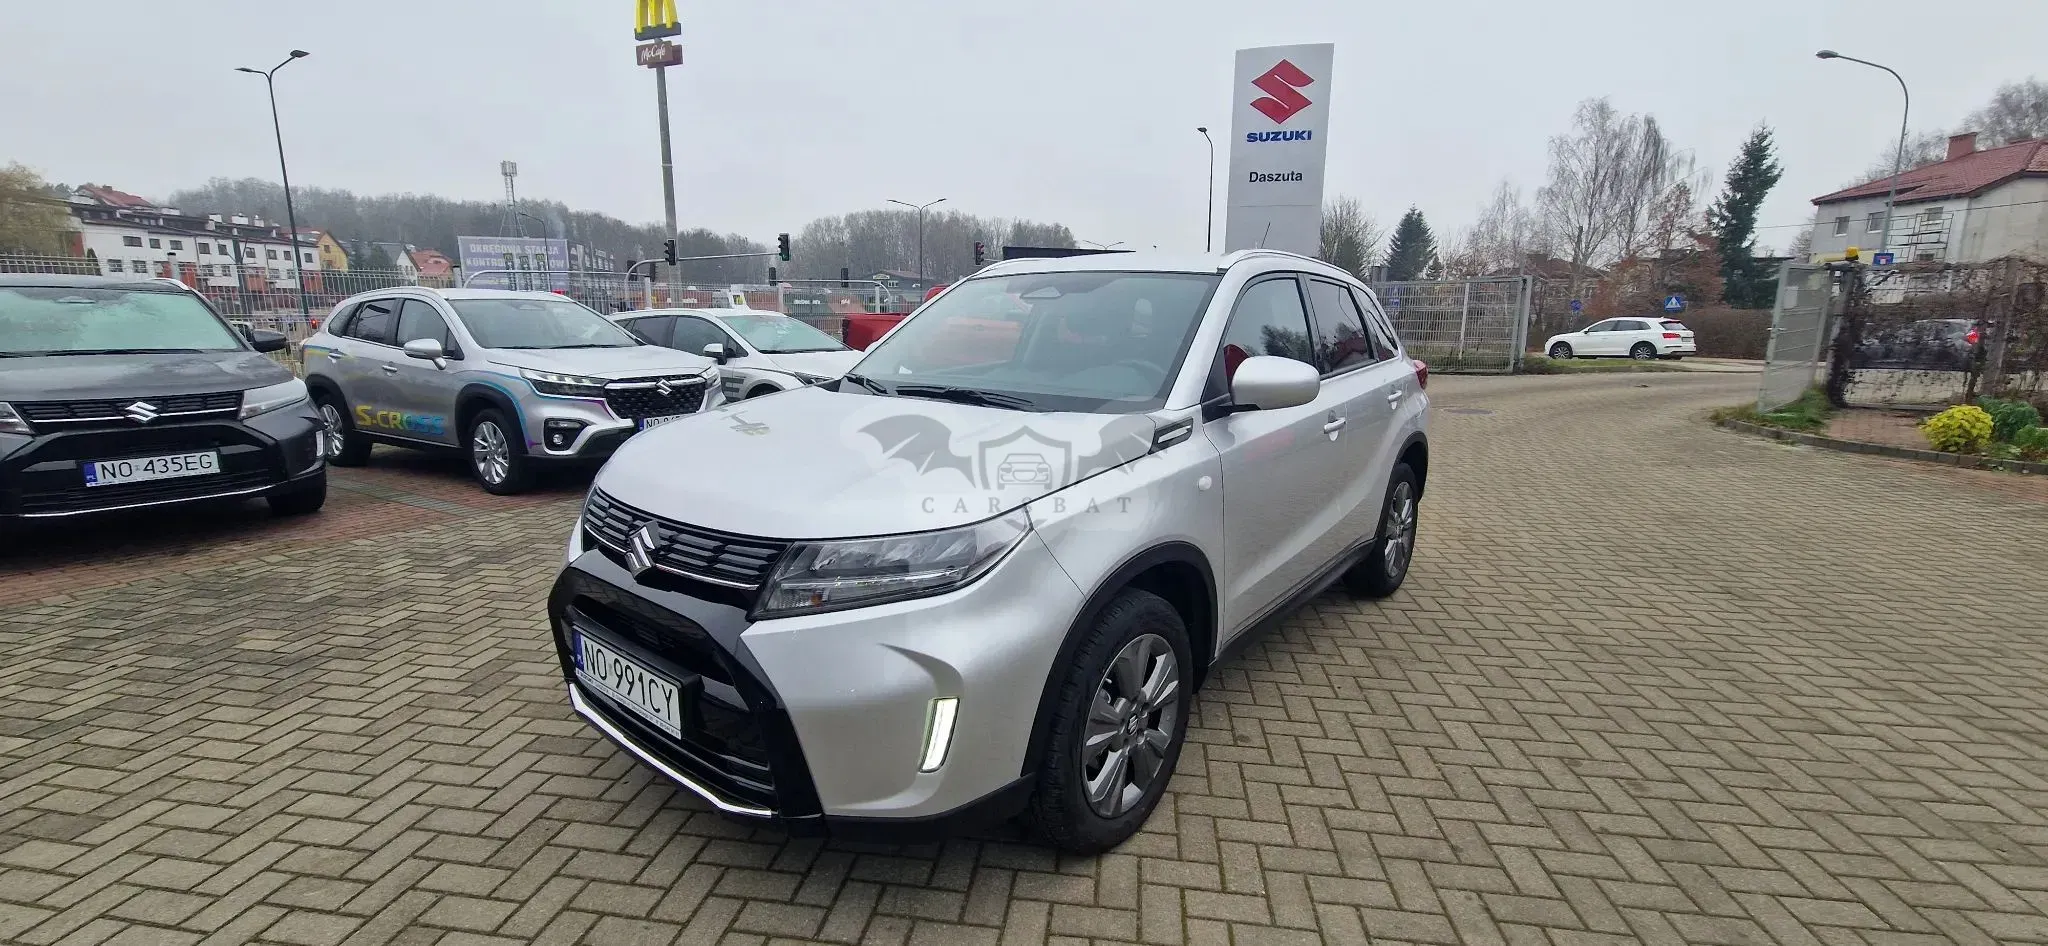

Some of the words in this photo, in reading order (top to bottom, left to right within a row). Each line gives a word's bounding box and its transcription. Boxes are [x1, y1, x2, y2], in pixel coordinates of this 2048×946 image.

[1246, 130, 1312, 143] SUZUKI
[1249, 171, 1303, 183] Daszuta
[101, 461, 133, 479] NO
[143, 454, 212, 475] 435EG
[583, 640, 607, 681] NO
[613, 657, 673, 721] 991CY
